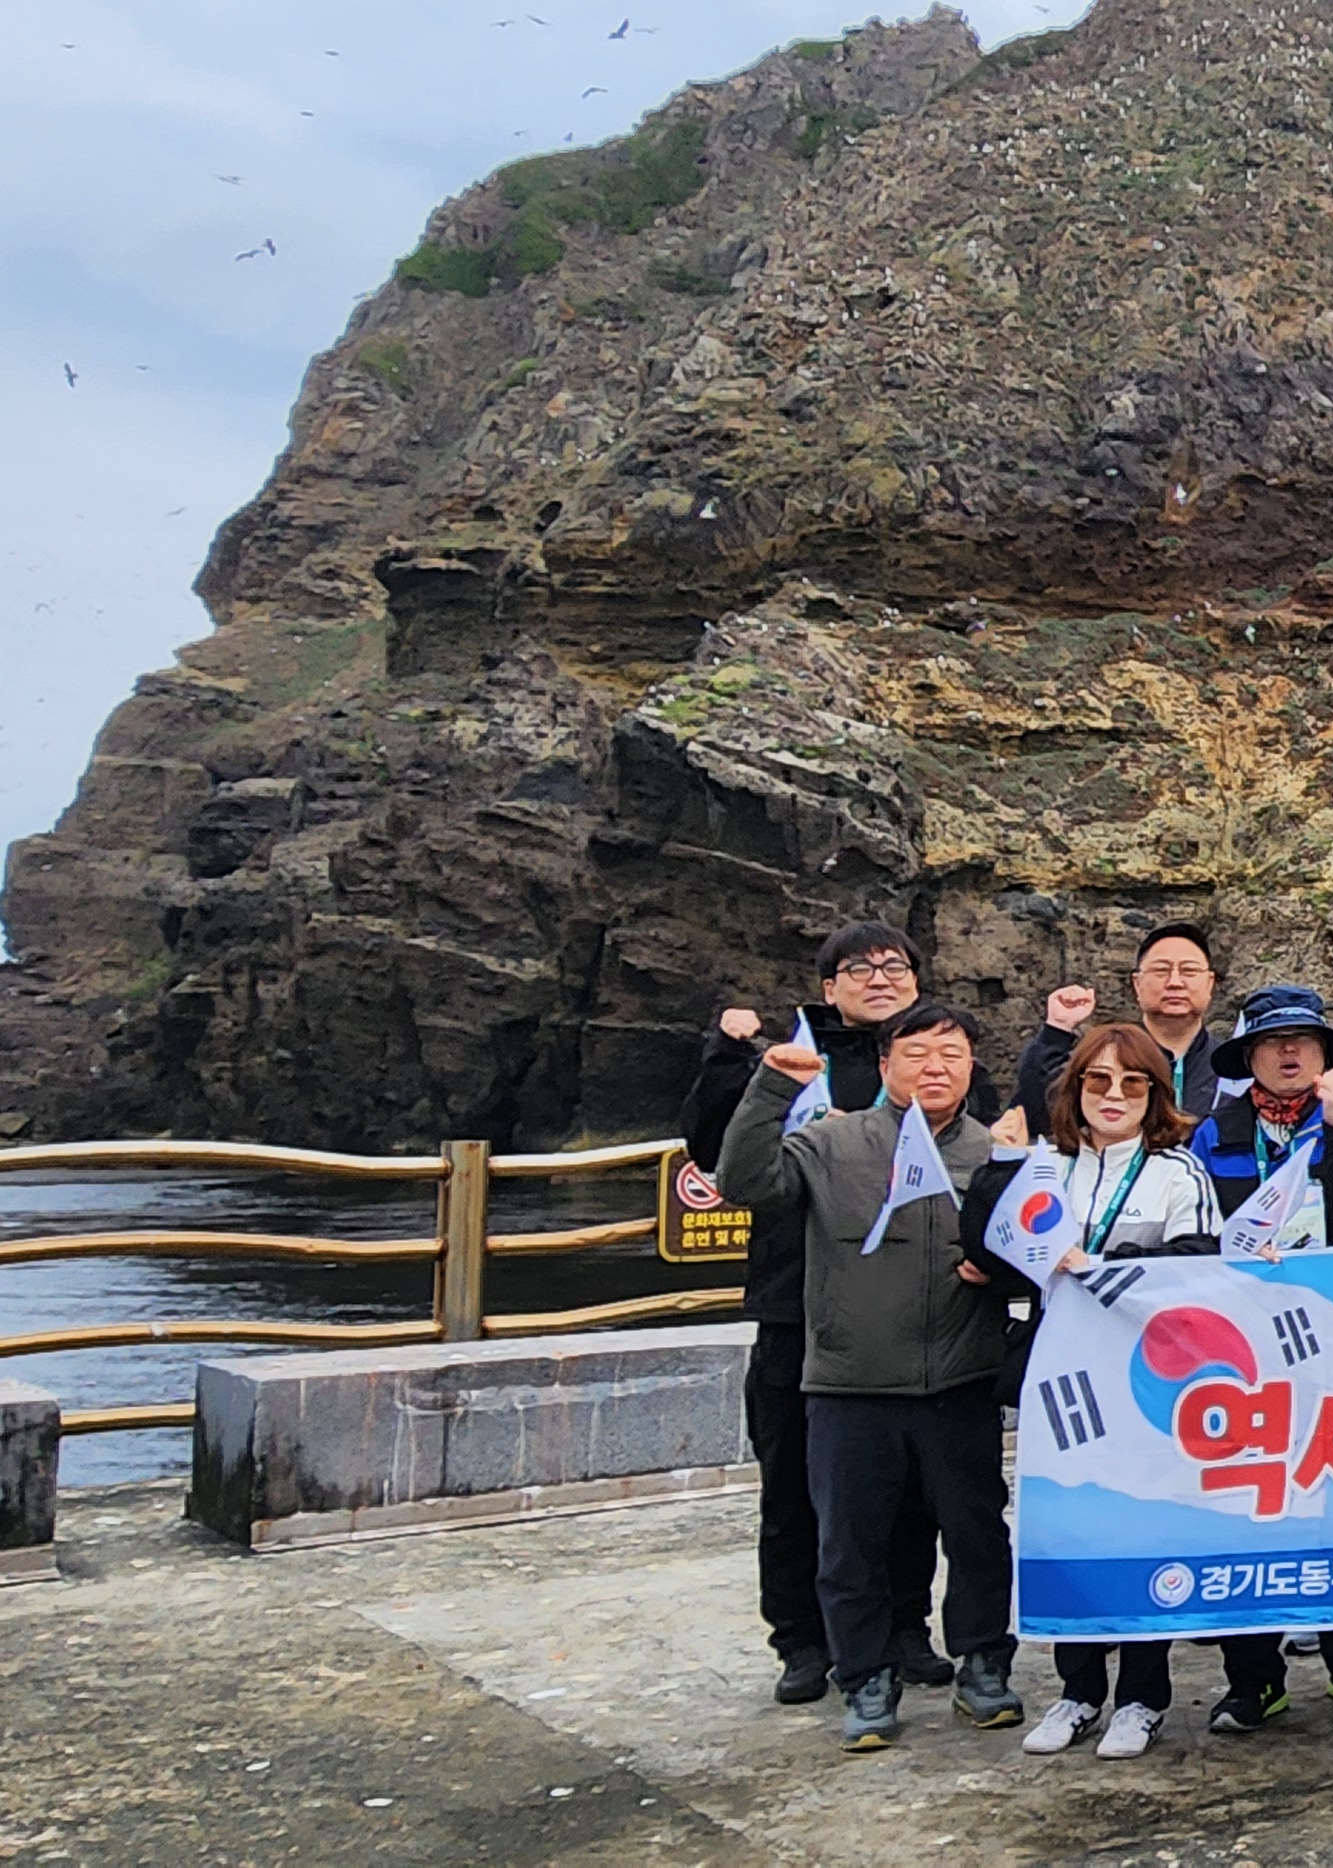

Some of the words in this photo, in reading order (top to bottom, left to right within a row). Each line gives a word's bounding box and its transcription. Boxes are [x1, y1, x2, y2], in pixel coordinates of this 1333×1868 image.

[682, 1210, 752, 1229] 문화재보호
[715, 1230, 729, 1247] 및
[733, 1229, 752, 1246] 취
